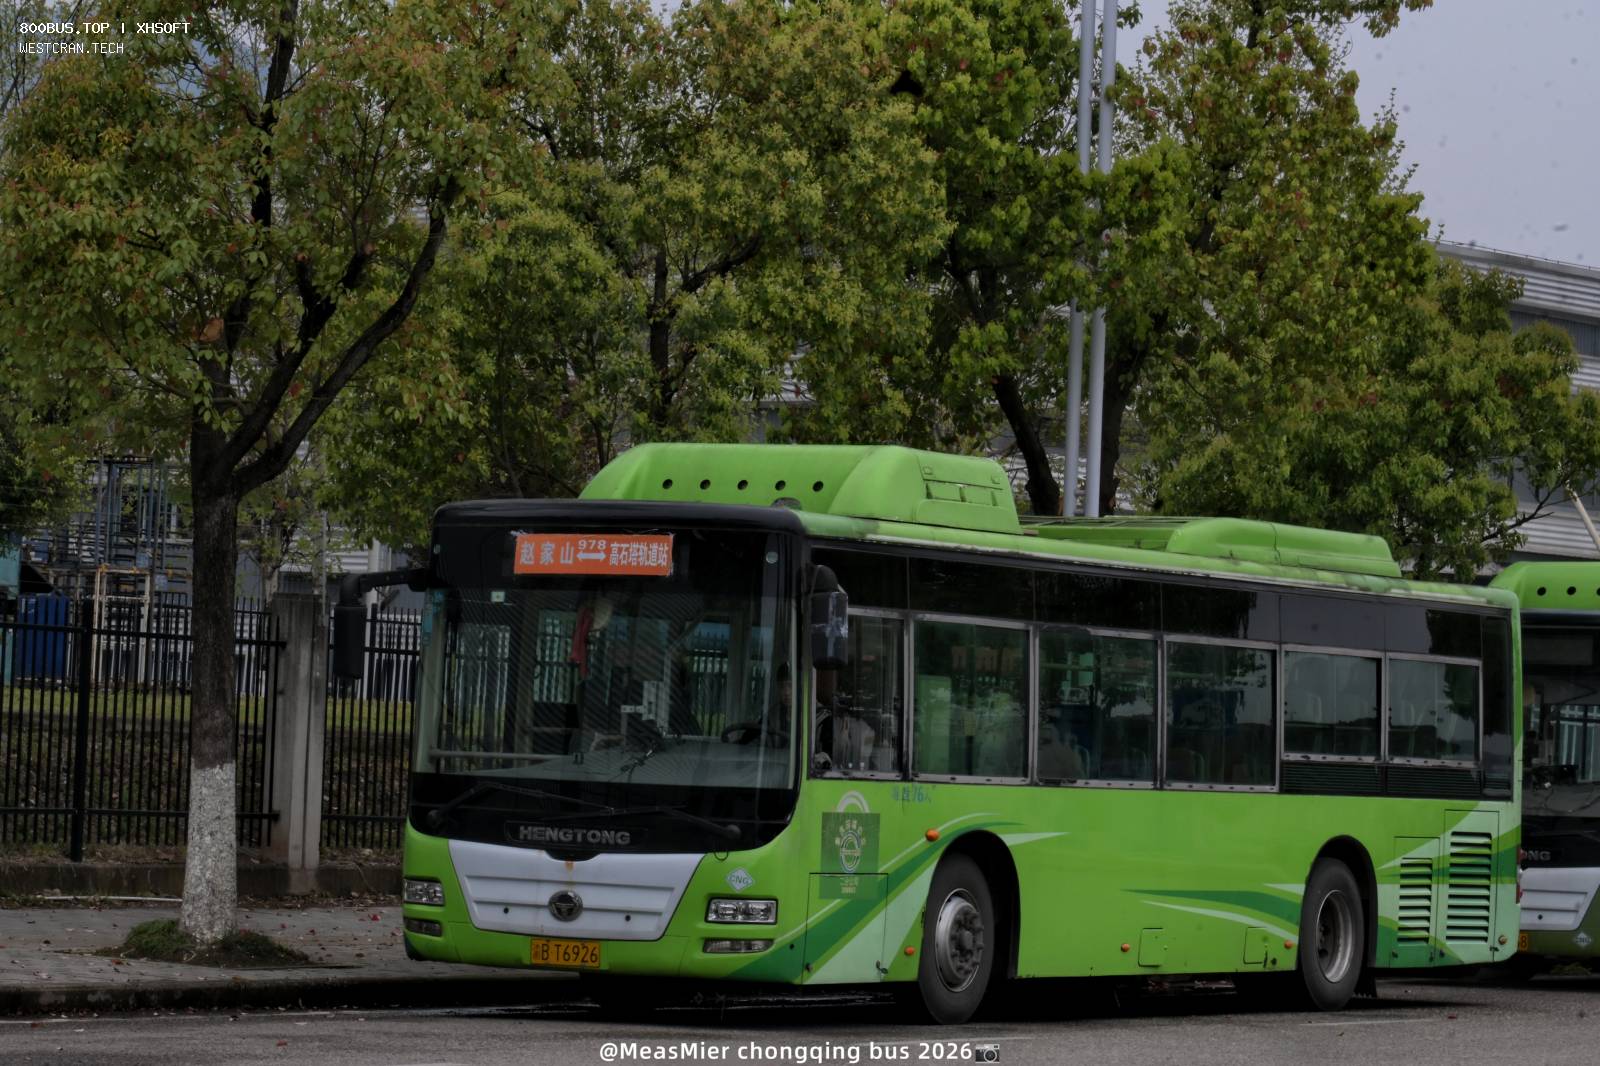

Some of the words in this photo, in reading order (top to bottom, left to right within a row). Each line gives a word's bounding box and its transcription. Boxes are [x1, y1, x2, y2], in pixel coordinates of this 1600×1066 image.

[578, 539, 607, 551] 978
[520, 541, 575, 565] 赵家山
[609, 542, 669, 568] 高石塔轨道站
[519, 825, 631, 845] HENGTONG
[728, 874, 749, 885] CNG
